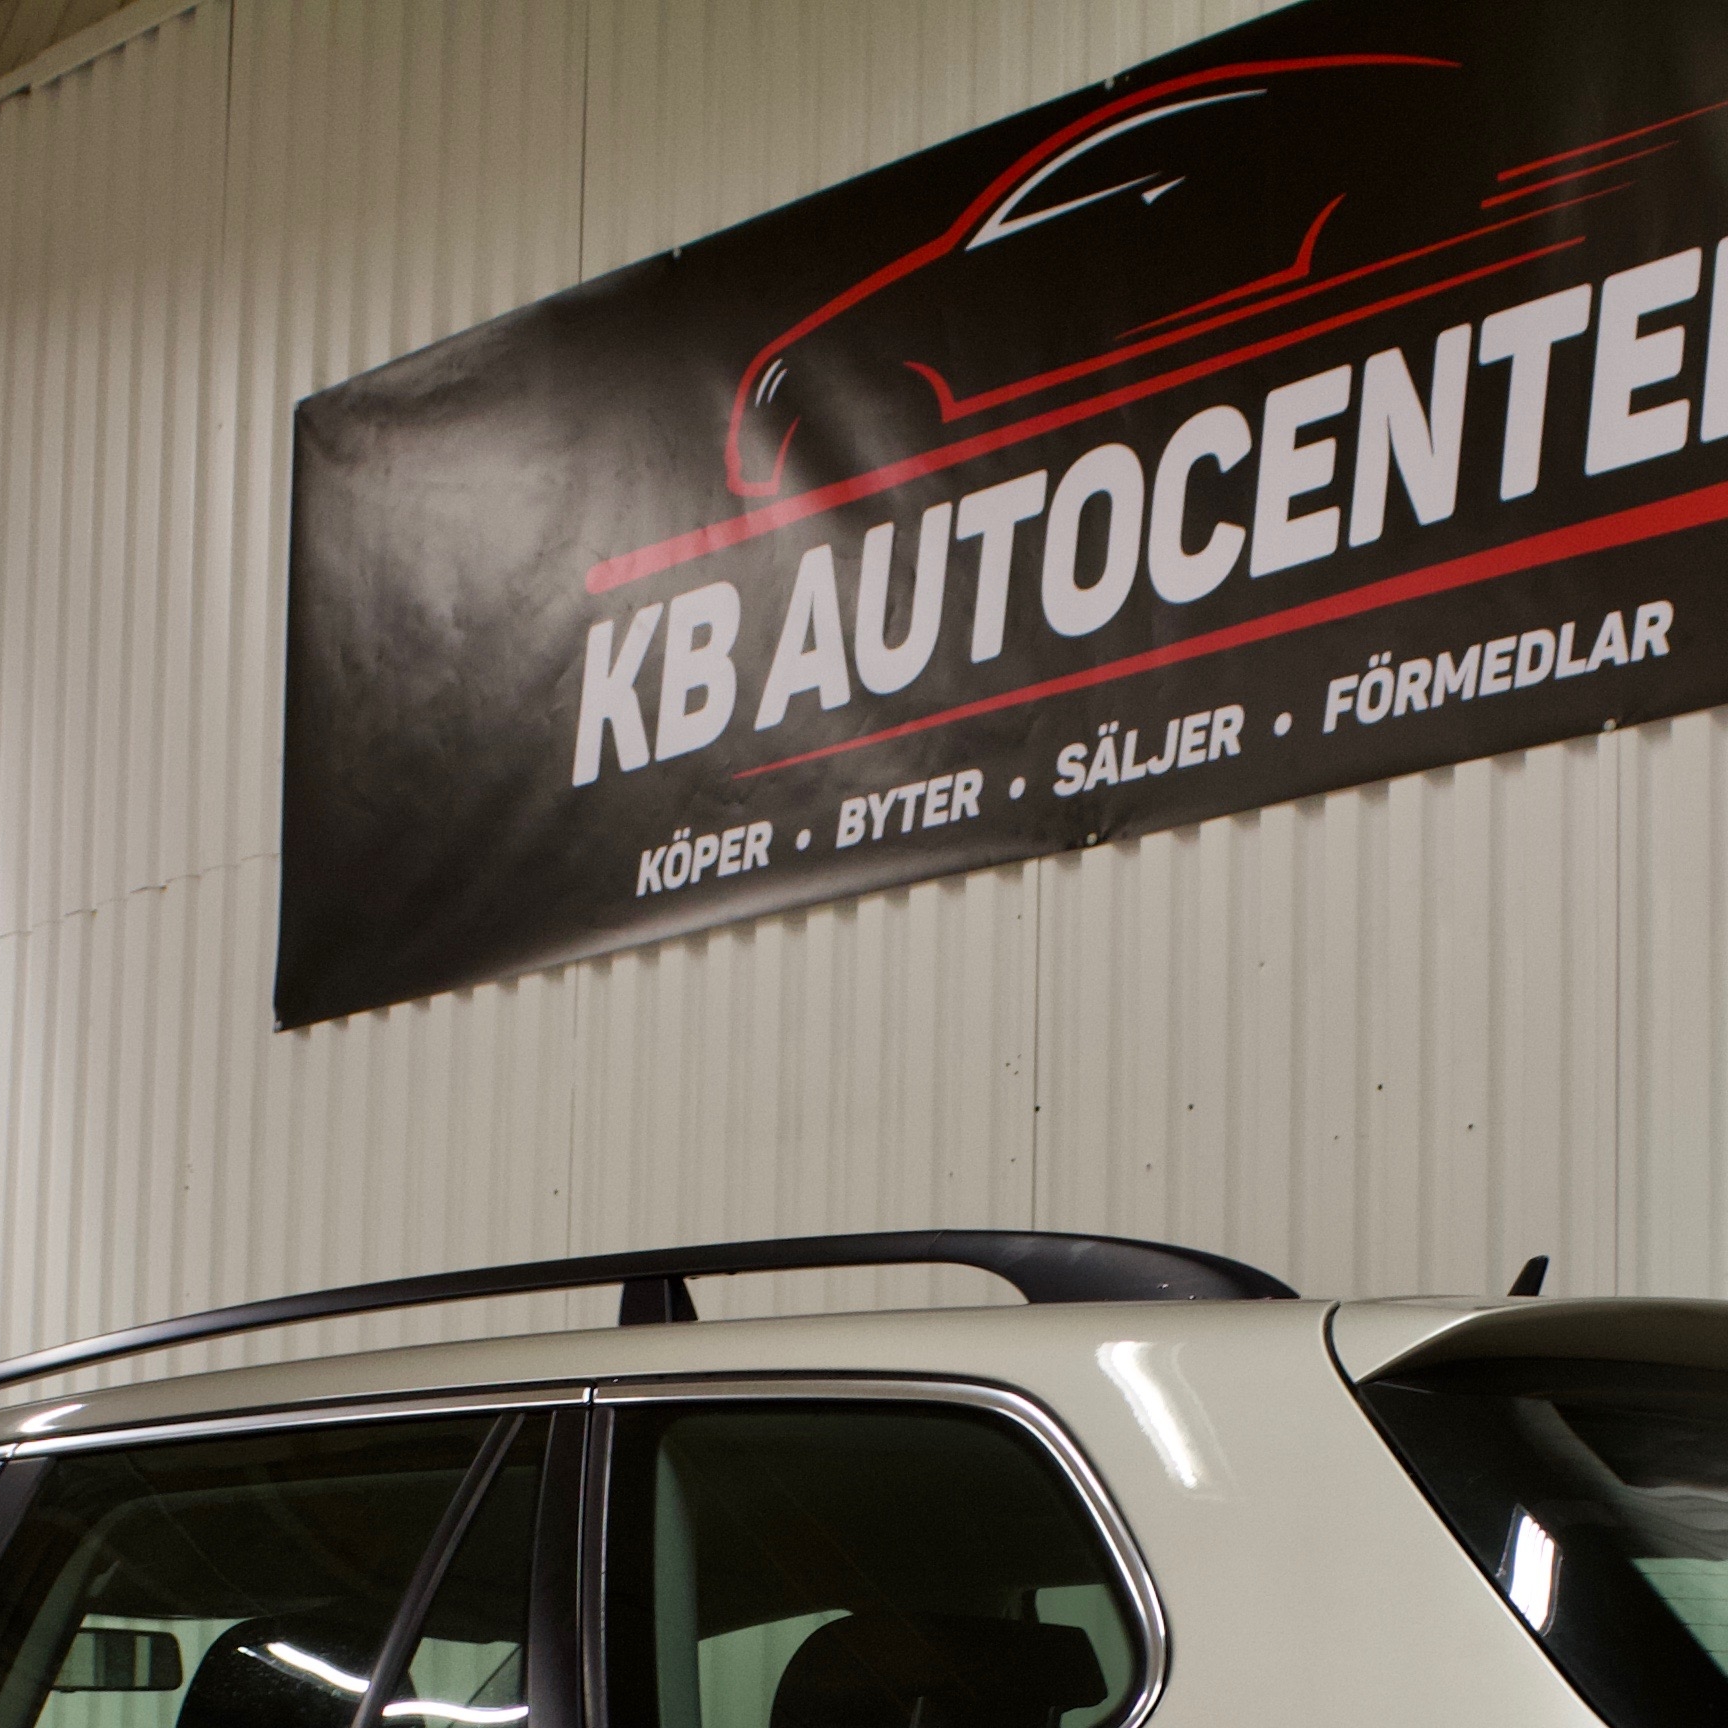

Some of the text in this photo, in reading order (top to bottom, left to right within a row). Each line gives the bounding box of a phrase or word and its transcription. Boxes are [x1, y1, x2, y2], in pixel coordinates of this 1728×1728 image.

[570, 580, 741, 788] KB
[635, 600, 1673, 897] KÖPER BYTER SÄLJER FÖRMEDLAR
